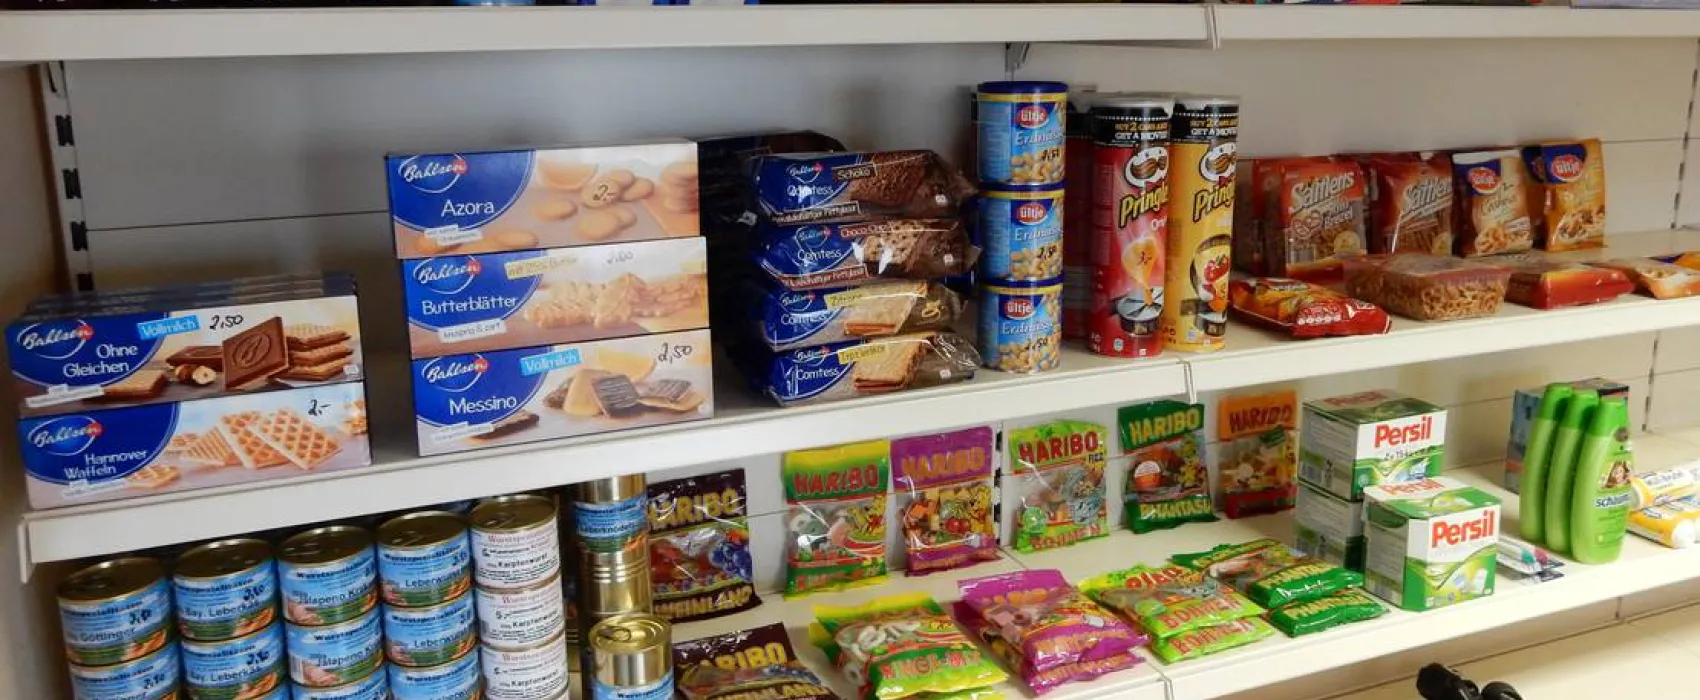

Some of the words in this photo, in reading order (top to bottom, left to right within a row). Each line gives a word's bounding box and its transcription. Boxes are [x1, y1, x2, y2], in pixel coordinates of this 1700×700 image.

[1115, 132, 1132, 140] GET
[1130, 121, 1137, 131] 2
[403, 160, 467, 183] Bahlsen
[441, 199, 495, 217] Azora
[418, 262, 480, 284] Bahlsen
[421, 297, 518, 315] Butterblätter
[1007, 301, 1033, 315] ültje
[141, 318, 197, 337] Vollmilch
[209, 314, 245, 330] 2,50
[23, 325, 94, 350] Bahlsen
[96, 343, 139, 359] Ohne
[657, 342, 693, 364] 2,50
[63, 360, 130, 378] Gleichen
[426, 359, 488, 383] Bahlsen
[525, 352, 577, 372] Vollmilch
[796, 367, 840, 381] Comtess
[449, 396, 517, 416] Messino
[1129, 407, 1201, 447] HARIBO
[1228, 404, 1293, 434] HARIBO
[33, 426, 100, 448] Bahlsen
[1374, 416, 1432, 449] Persil
[1018, 430, 1098, 464] HARIBO
[85, 450, 148, 466] Hannover
[901, 446, 986, 480] HARIBO
[63, 464, 117, 481] Waffeln
[793, 463, 880, 496] HARIBO
[1431, 508, 1496, 549] Persil
